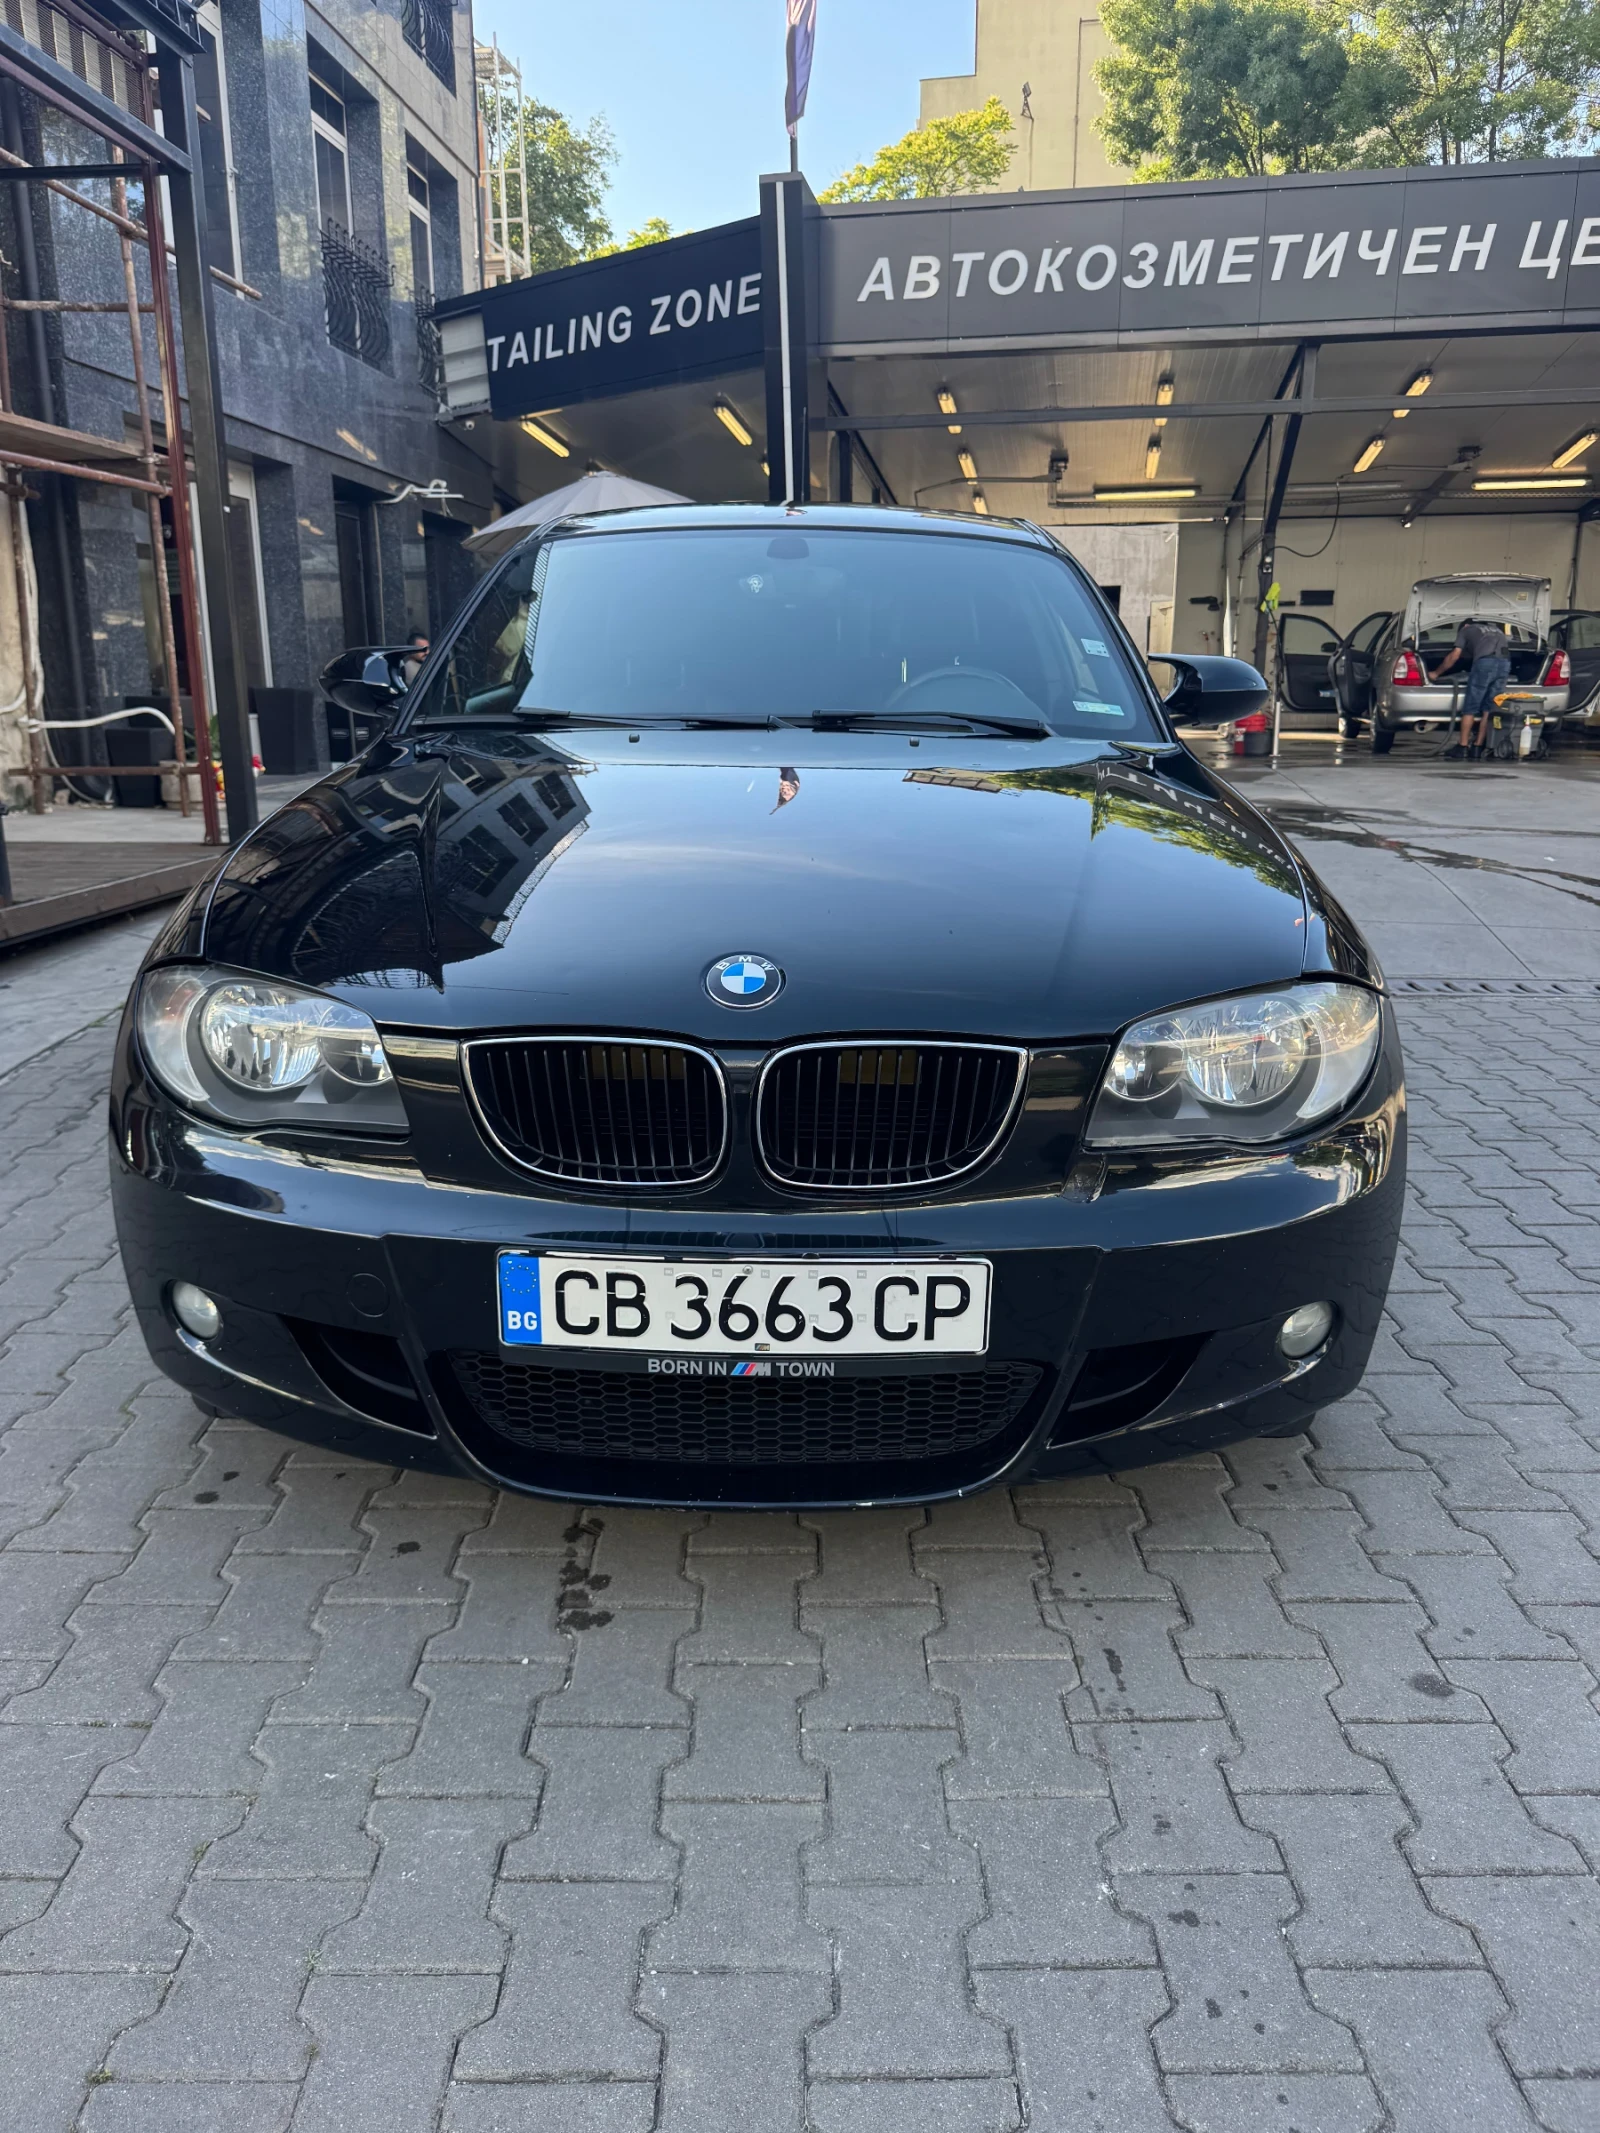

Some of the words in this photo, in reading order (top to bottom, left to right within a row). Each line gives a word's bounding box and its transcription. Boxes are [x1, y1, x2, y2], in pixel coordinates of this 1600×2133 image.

[856, 222, 1498, 302] АВТОКОЗМЕТИЧЕН
[486, 304, 634, 373] TAILING
[649, 272, 762, 336] ZONE
[715, 955, 775, 972] BMW
[507, 1310, 538, 1331] BG
[554, 1269, 651, 1338] CB
[670, 1274, 854, 1343] 3663
[874, 1275, 971, 1343] CP
[647, 1358, 703, 1375] BORN
[708, 1361, 727, 1376] IN
[775, 1362, 835, 1377] TOWN
